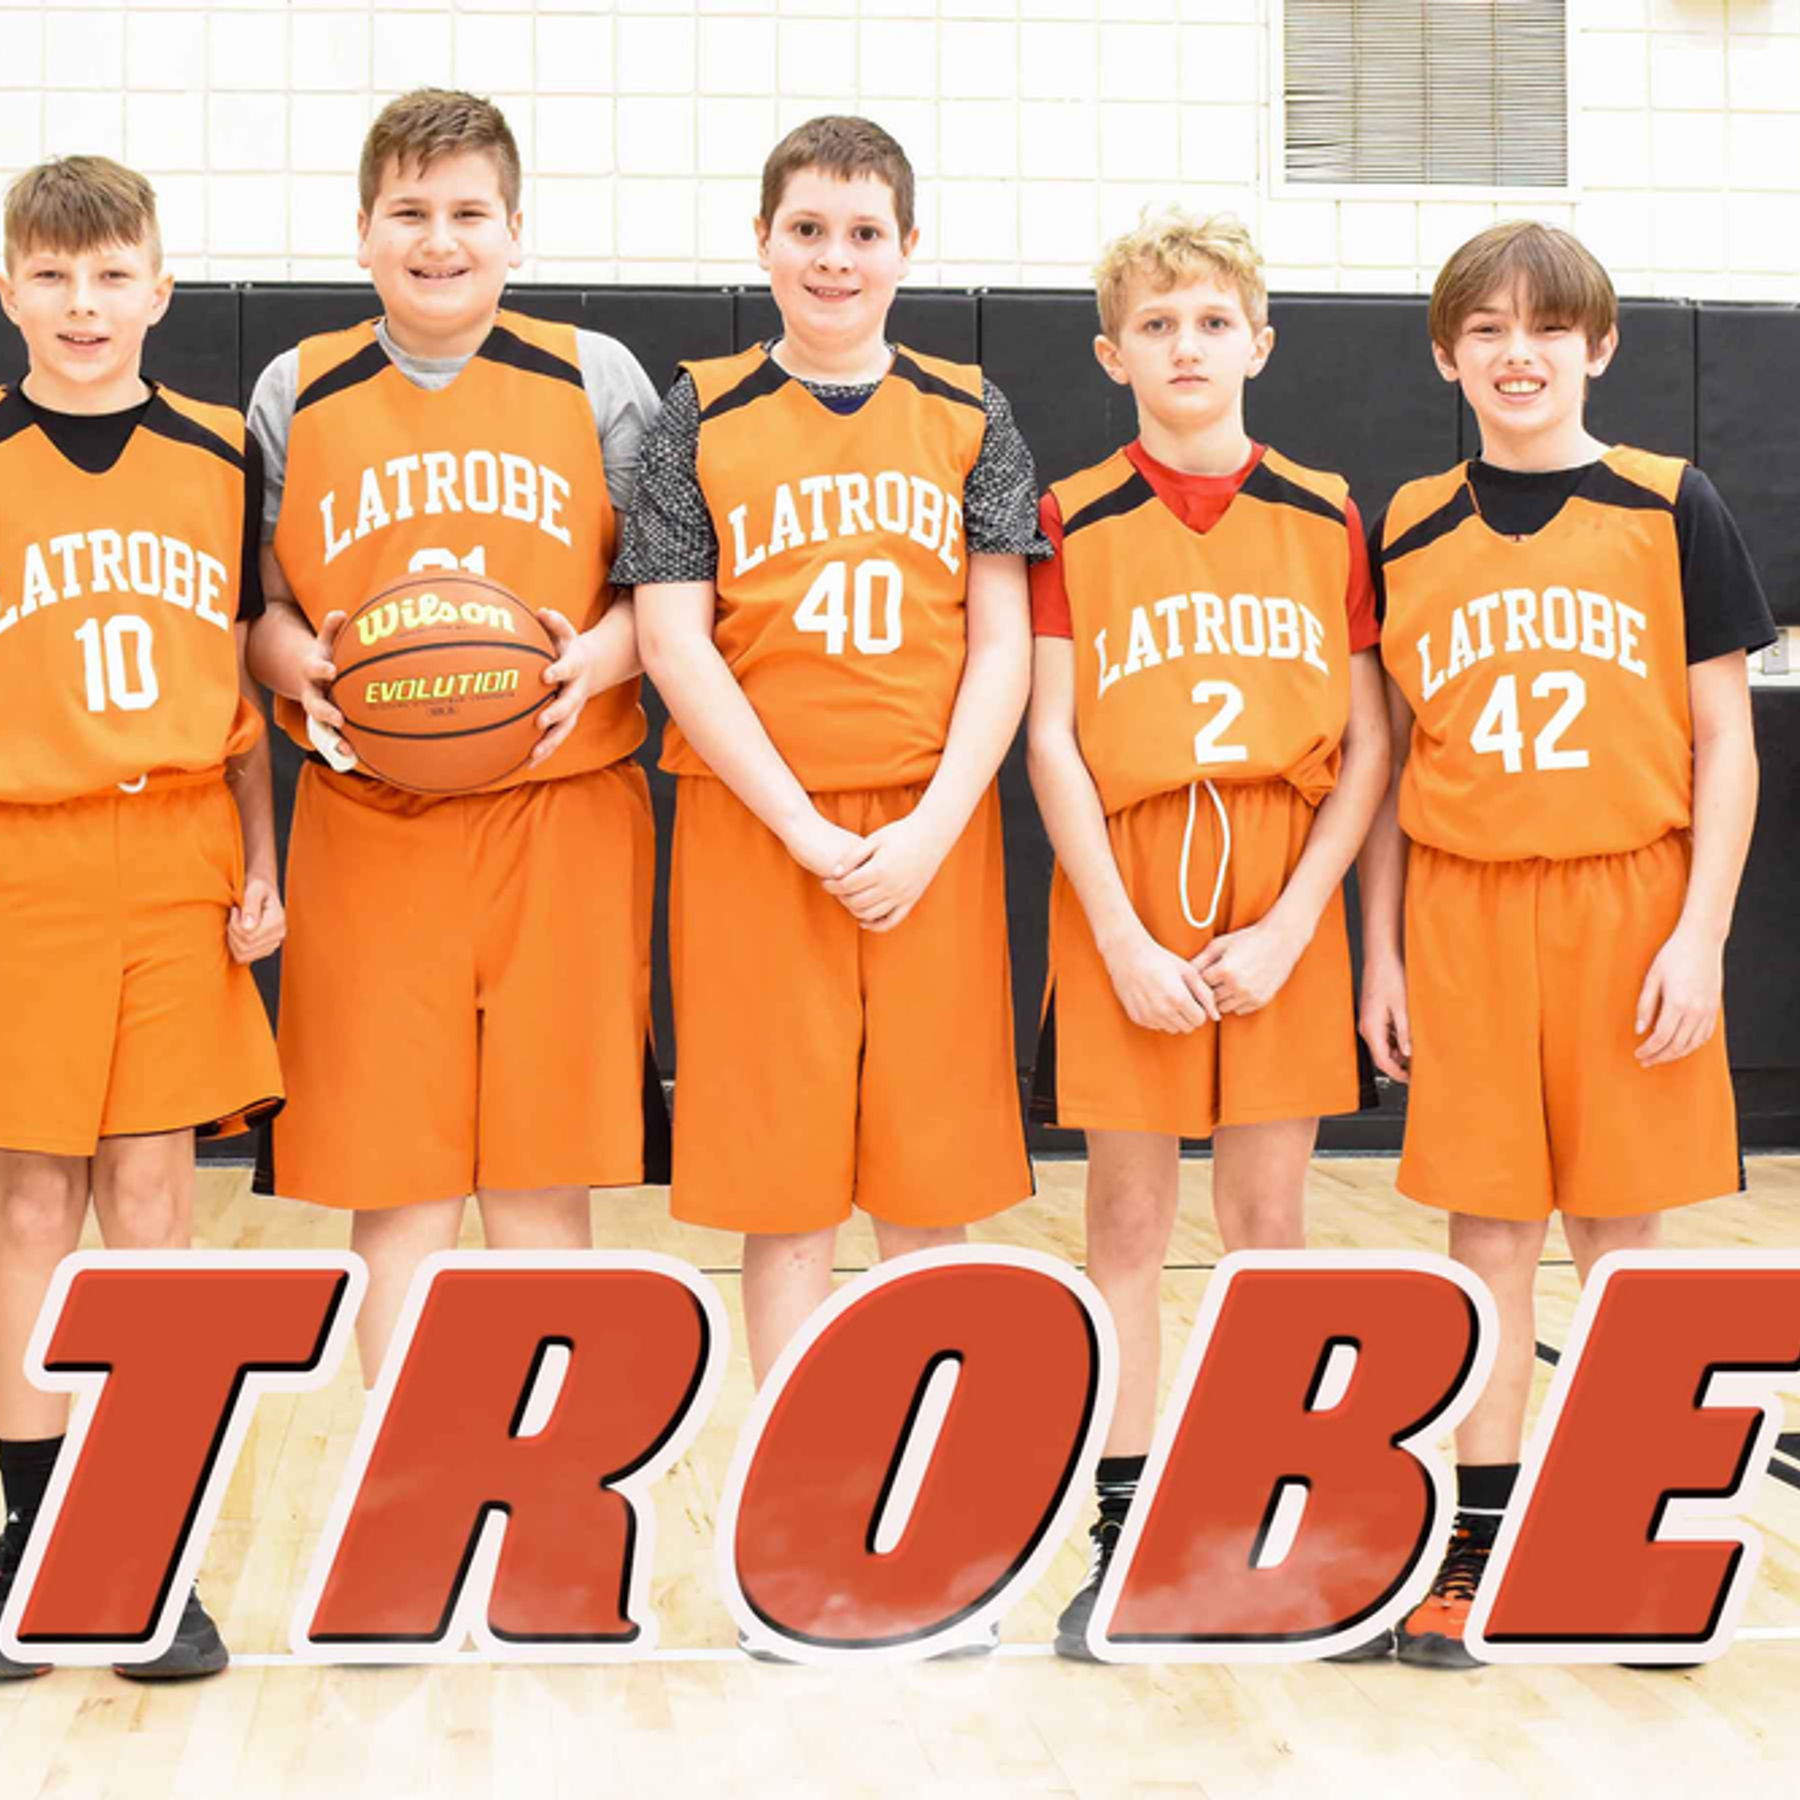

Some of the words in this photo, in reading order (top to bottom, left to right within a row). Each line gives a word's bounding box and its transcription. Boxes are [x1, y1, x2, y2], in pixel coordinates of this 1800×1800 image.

[319, 449, 573, 565] LATROBE
[728, 470, 964, 578] LATROBE
[356, 592, 516, 646] Wilson
[792, 559, 904, 656] 40
[1094, 591, 1330, 697] LATROBE
[1417, 586, 1648, 702] LATROBE
[74, 614, 160, 713] 10
[364, 668, 520, 704] EVOLUTION
[1191, 680, 1249, 766] 2
[1469, 670, 1591, 774] 42
